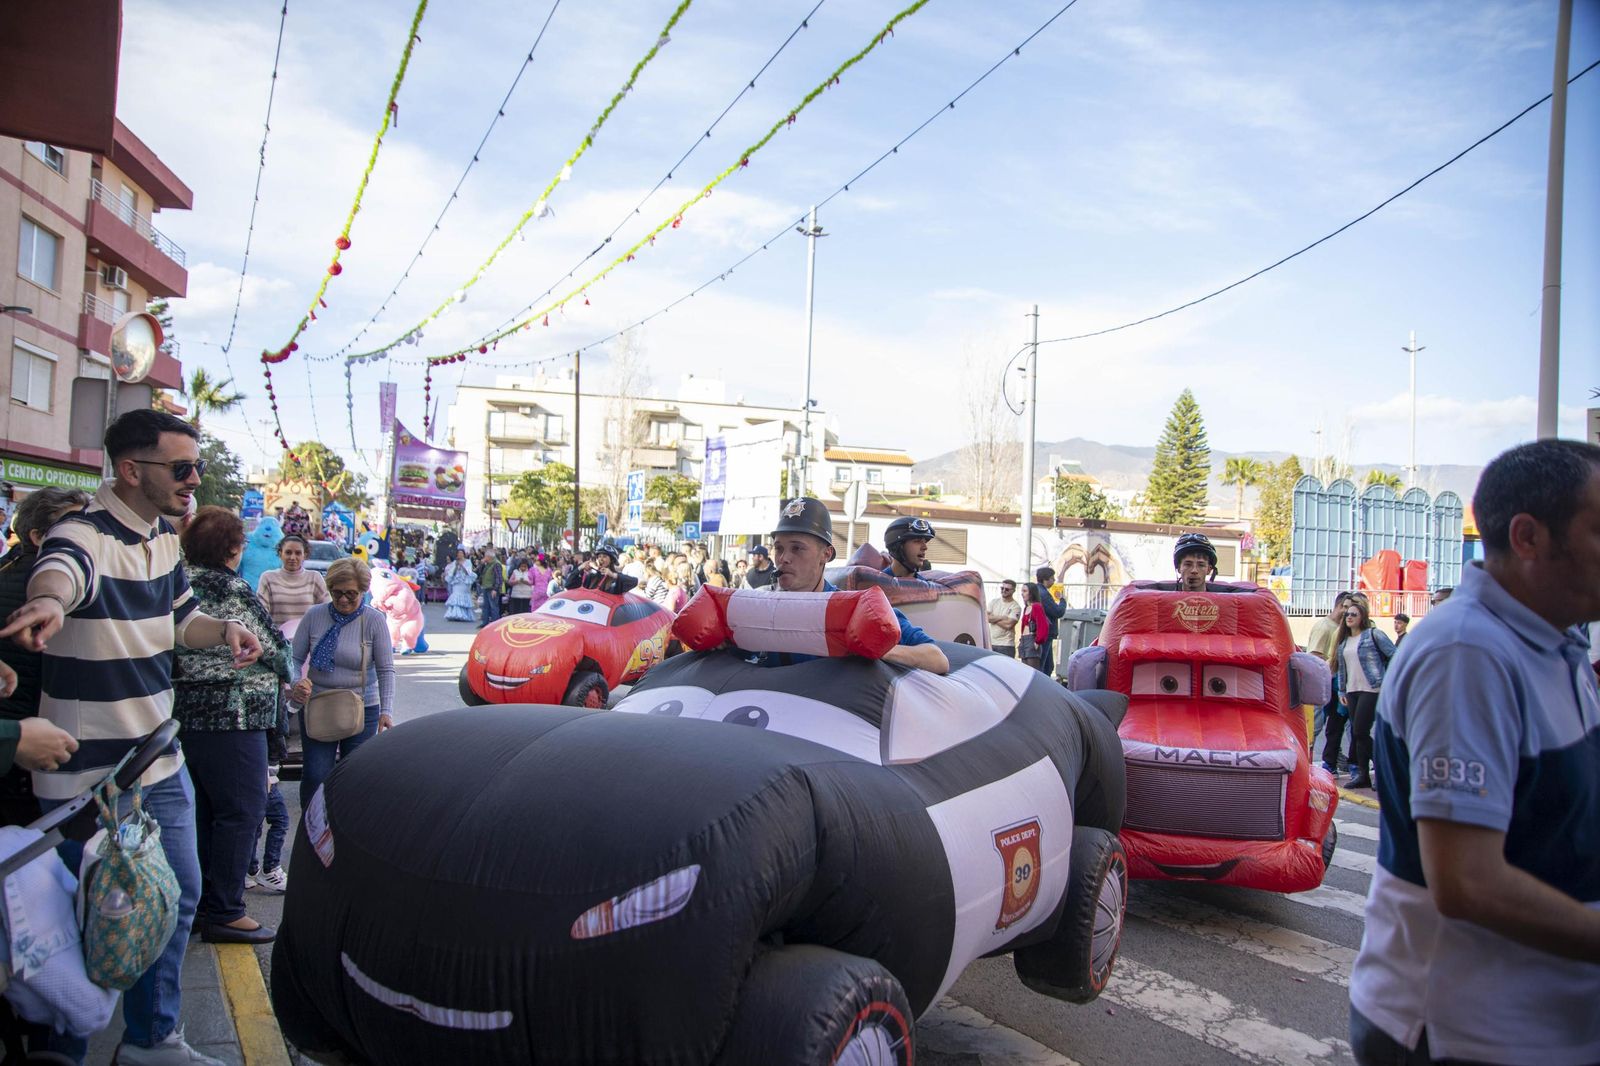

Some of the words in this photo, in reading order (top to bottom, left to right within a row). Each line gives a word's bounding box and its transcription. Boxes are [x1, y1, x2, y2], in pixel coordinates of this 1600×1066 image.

[8, 463, 43, 481] CENTRO
[46, 469, 76, 486] OPTICO
[686, 526, 695, 537] P
[1154, 747, 1261, 767] MACK
[1420, 756, 1485, 787] 1933
[1000, 833, 1020, 847] POLICE
[1015, 863, 1031, 883] 39
